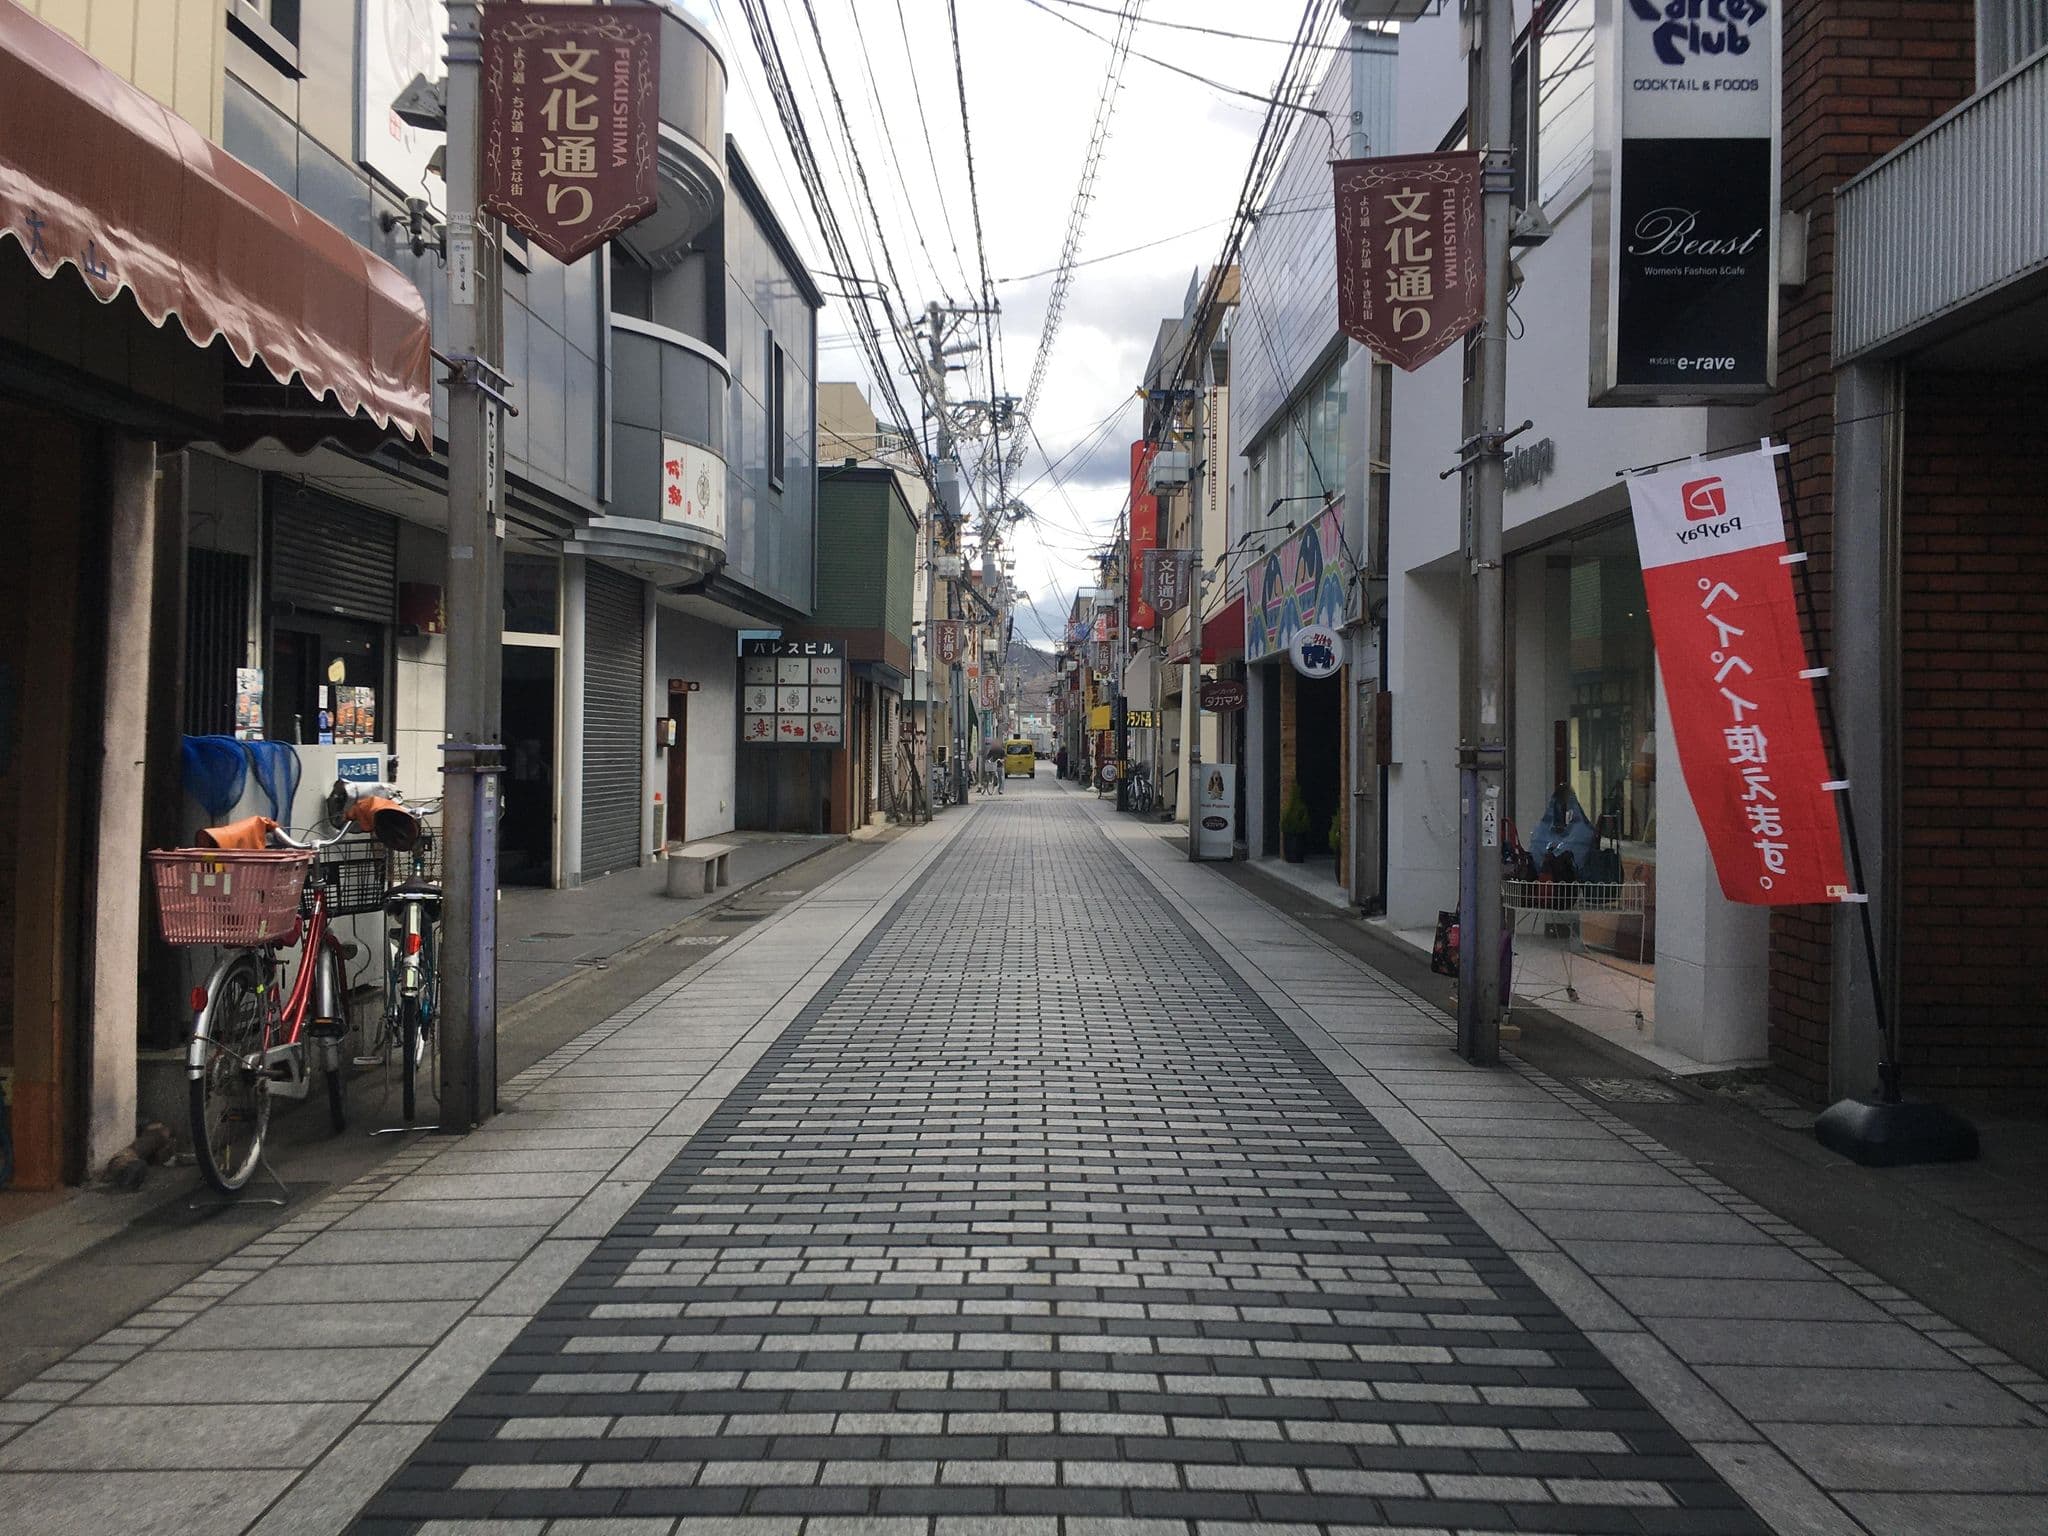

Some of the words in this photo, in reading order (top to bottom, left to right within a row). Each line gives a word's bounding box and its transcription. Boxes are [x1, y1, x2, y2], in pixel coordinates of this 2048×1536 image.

[1653, 20, 1751, 66] Club
[611, 47, 630, 168] FUKUSHIMA
[1633, 79, 1699, 91] COCKTAIL
[1702, 80, 1711, 91] &
[1714, 79, 1759, 91] FOODS
[539, 41, 599, 226] 文化通り
[1442, 188, 1457, 289] FUKUSHIMA
[1628, 207, 1763, 256] Beast
[1383, 186, 1434, 342] 文化通り
[1644, 266, 1682, 276] Women's
[1684, 266, 1718, 276] Fashion
[1677, 357, 1736, 370] e-rave
[1158, 559, 1175, 611] 文化通り
[943, 626, 955, 660] 文化通り
[1205, 695, 1243, 707] タカマツ
